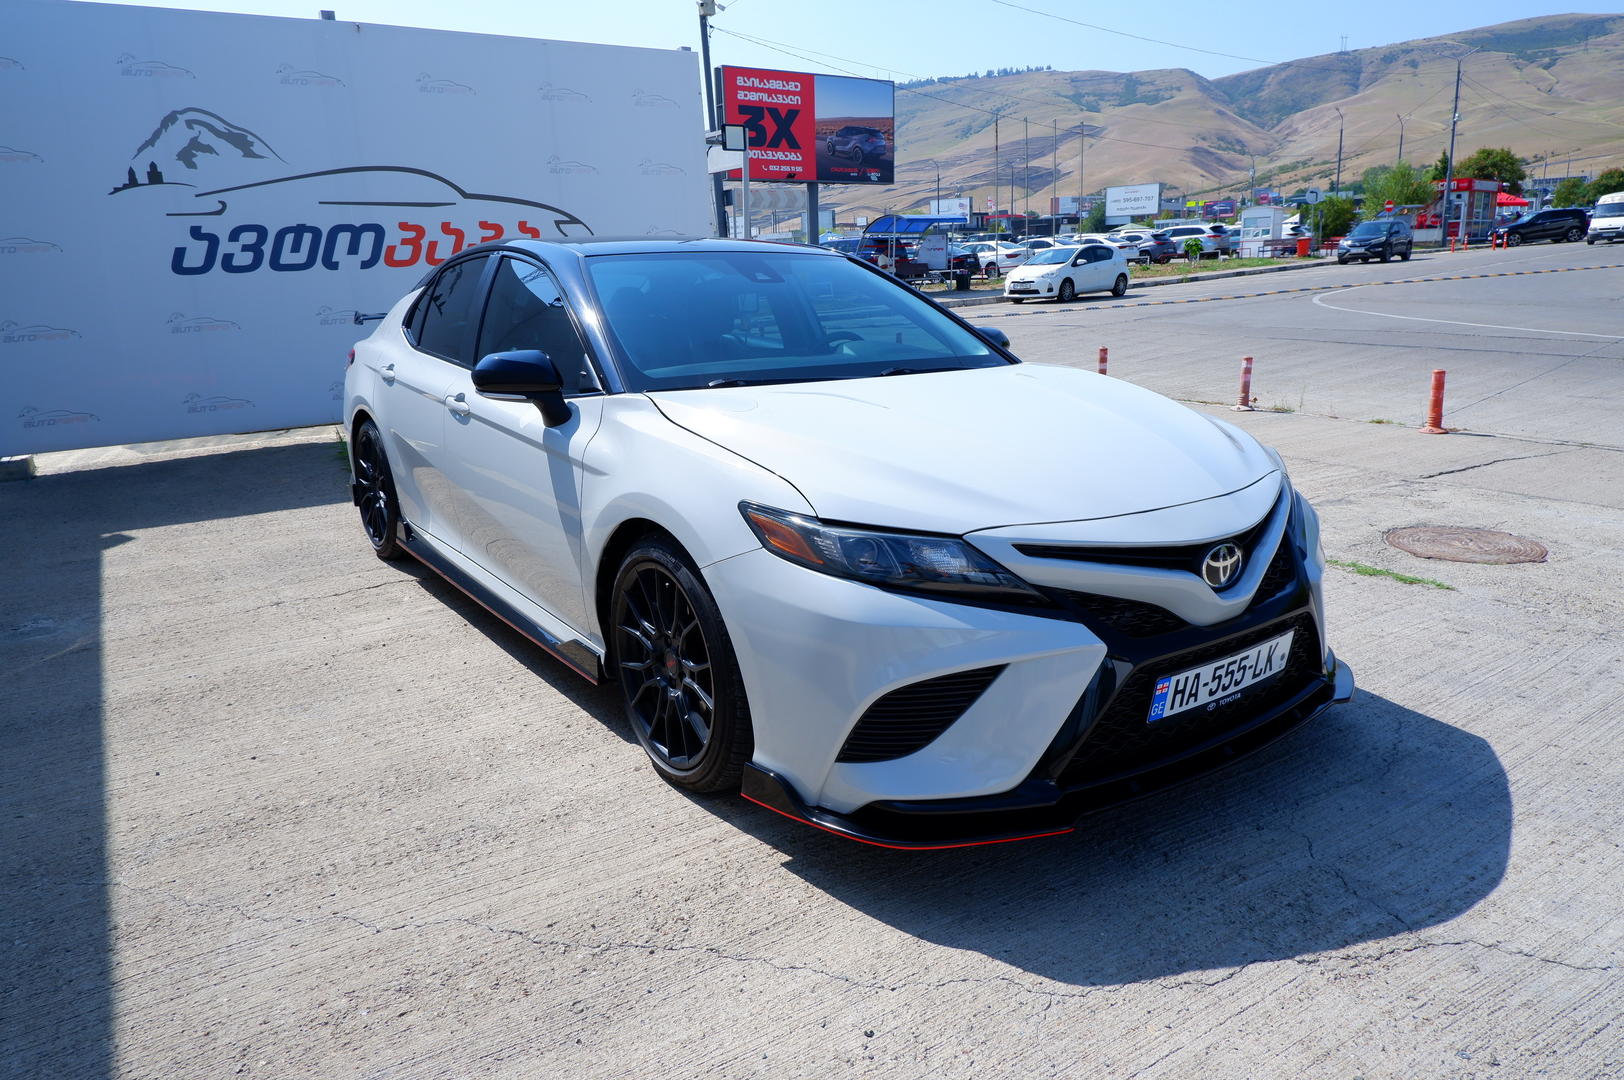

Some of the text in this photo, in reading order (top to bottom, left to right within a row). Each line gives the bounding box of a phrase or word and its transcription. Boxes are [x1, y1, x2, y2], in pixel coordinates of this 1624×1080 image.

[1170, 642, 1280, 711] HA-555-LK
[1219, 693, 1241, 706] TOYOTA
[1151, 702, 1165, 716] GE
